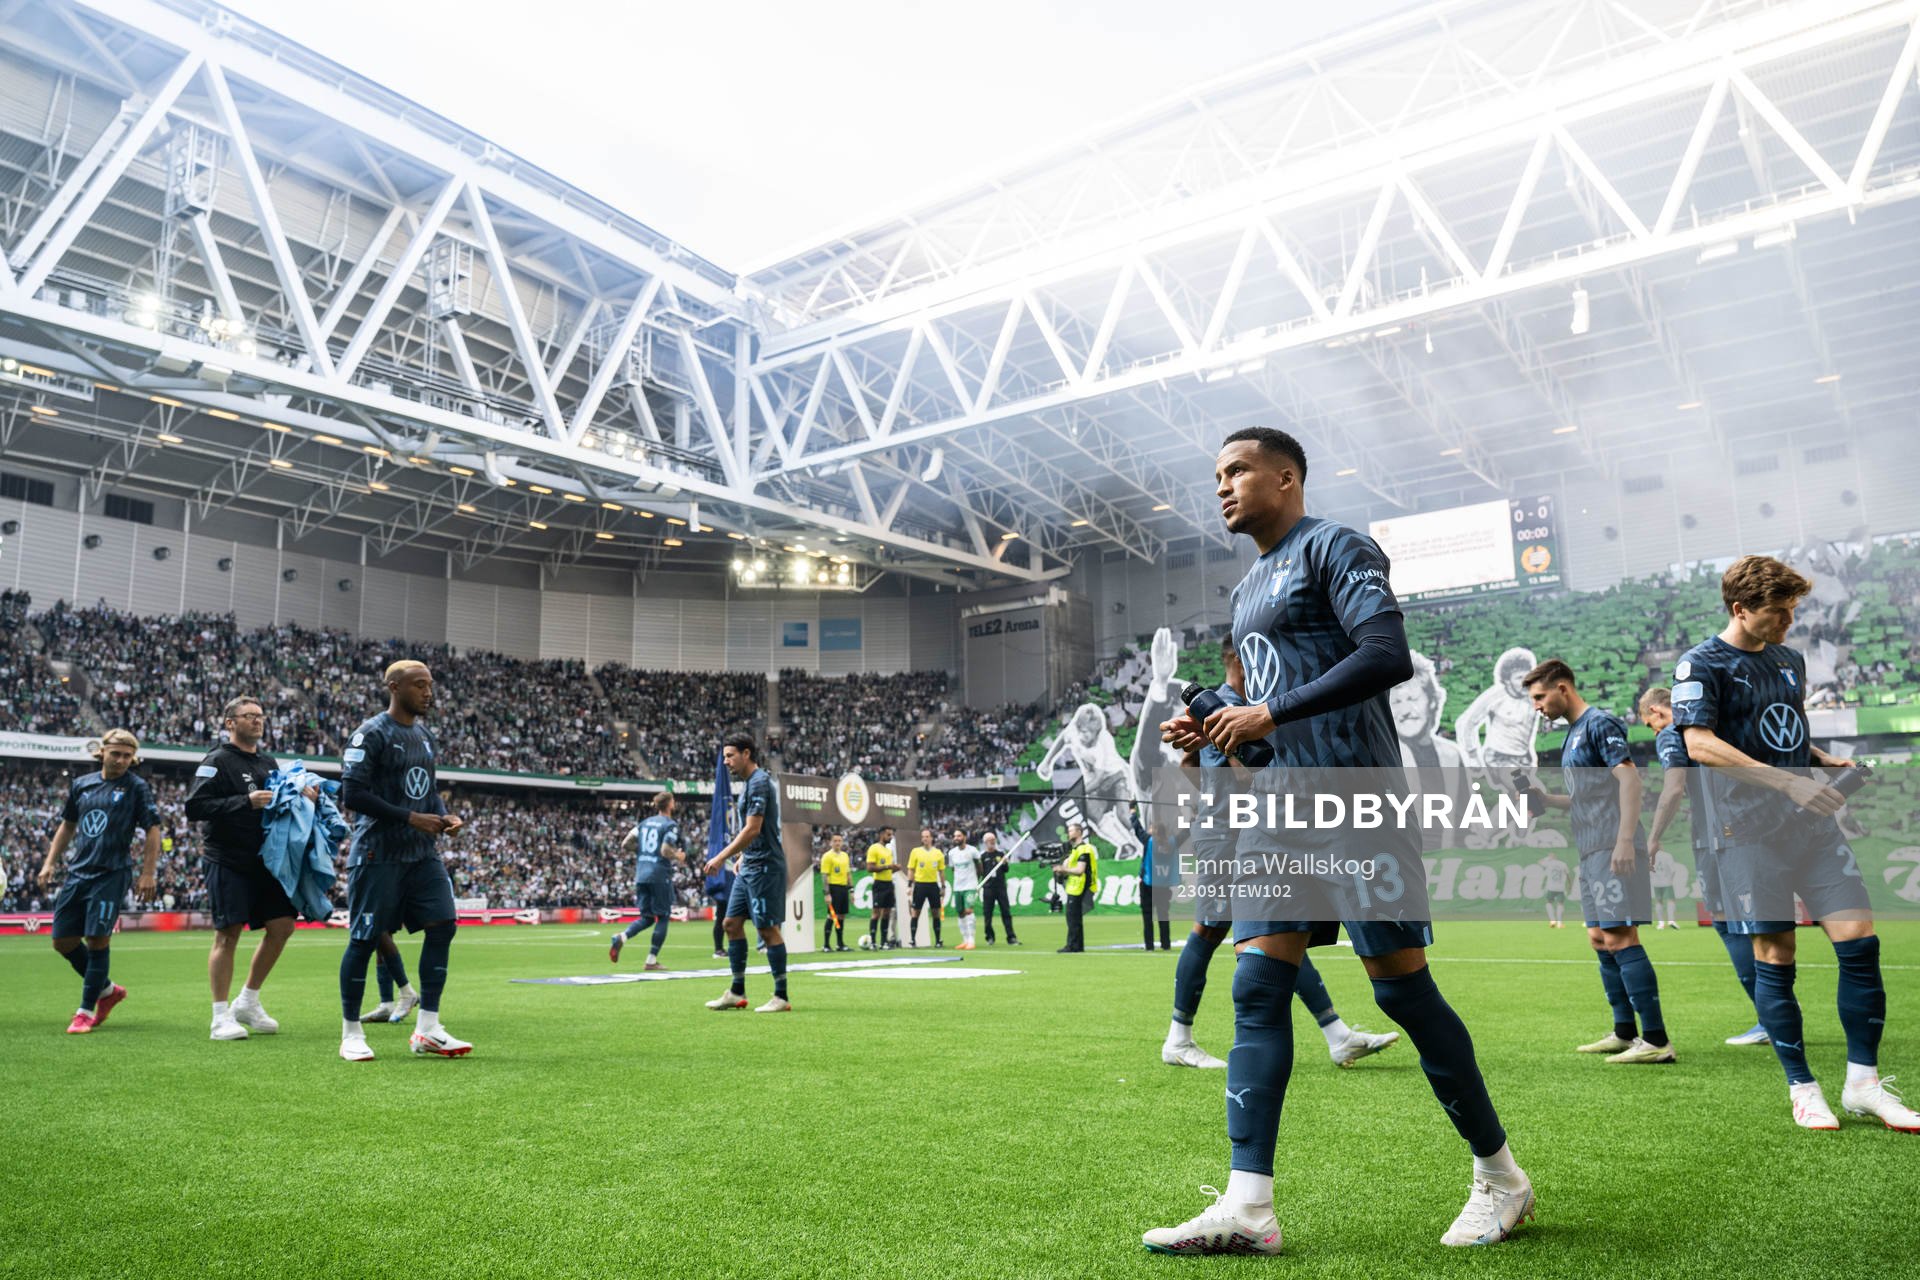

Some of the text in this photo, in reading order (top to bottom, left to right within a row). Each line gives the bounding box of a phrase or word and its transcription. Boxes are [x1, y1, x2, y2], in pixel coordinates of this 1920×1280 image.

[1514, 509, 1524, 523] 0
[1537, 505, 1548, 520] 0
[1517, 527, 1549, 542] 00:00
[967, 617, 1040, 638] TELE2 Arena
[786, 784, 829, 802] UNIBET
[875, 792, 912, 809] UNIBET
[640, 827, 659, 853] 18
[1155, 865, 1170, 878] TV
[1352, 852, 1405, 909] 13
[1592, 878, 1624, 906] 23
[751, 897, 767, 915] 21
